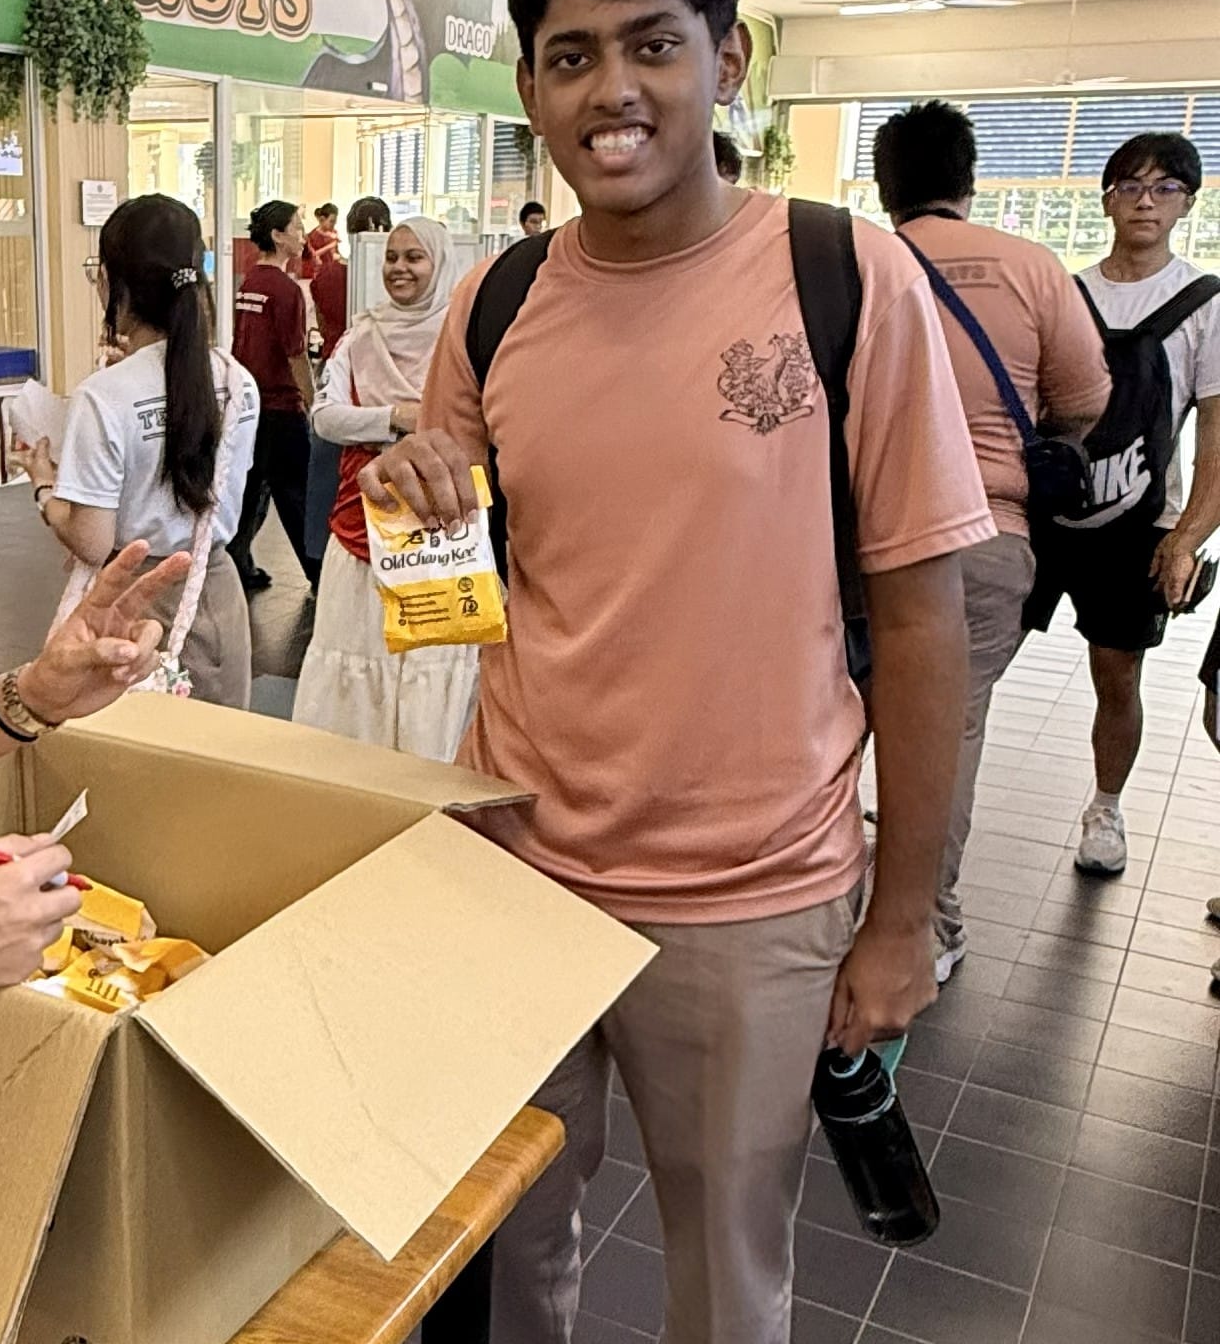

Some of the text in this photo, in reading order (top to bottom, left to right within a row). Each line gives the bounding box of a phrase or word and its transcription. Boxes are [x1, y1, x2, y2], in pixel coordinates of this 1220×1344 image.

[447, 19, 492, 55] DRACO
[380, 554, 405, 571] Old
[406, 550, 450, 567] Chang
[451, 546, 477, 562] Kee
